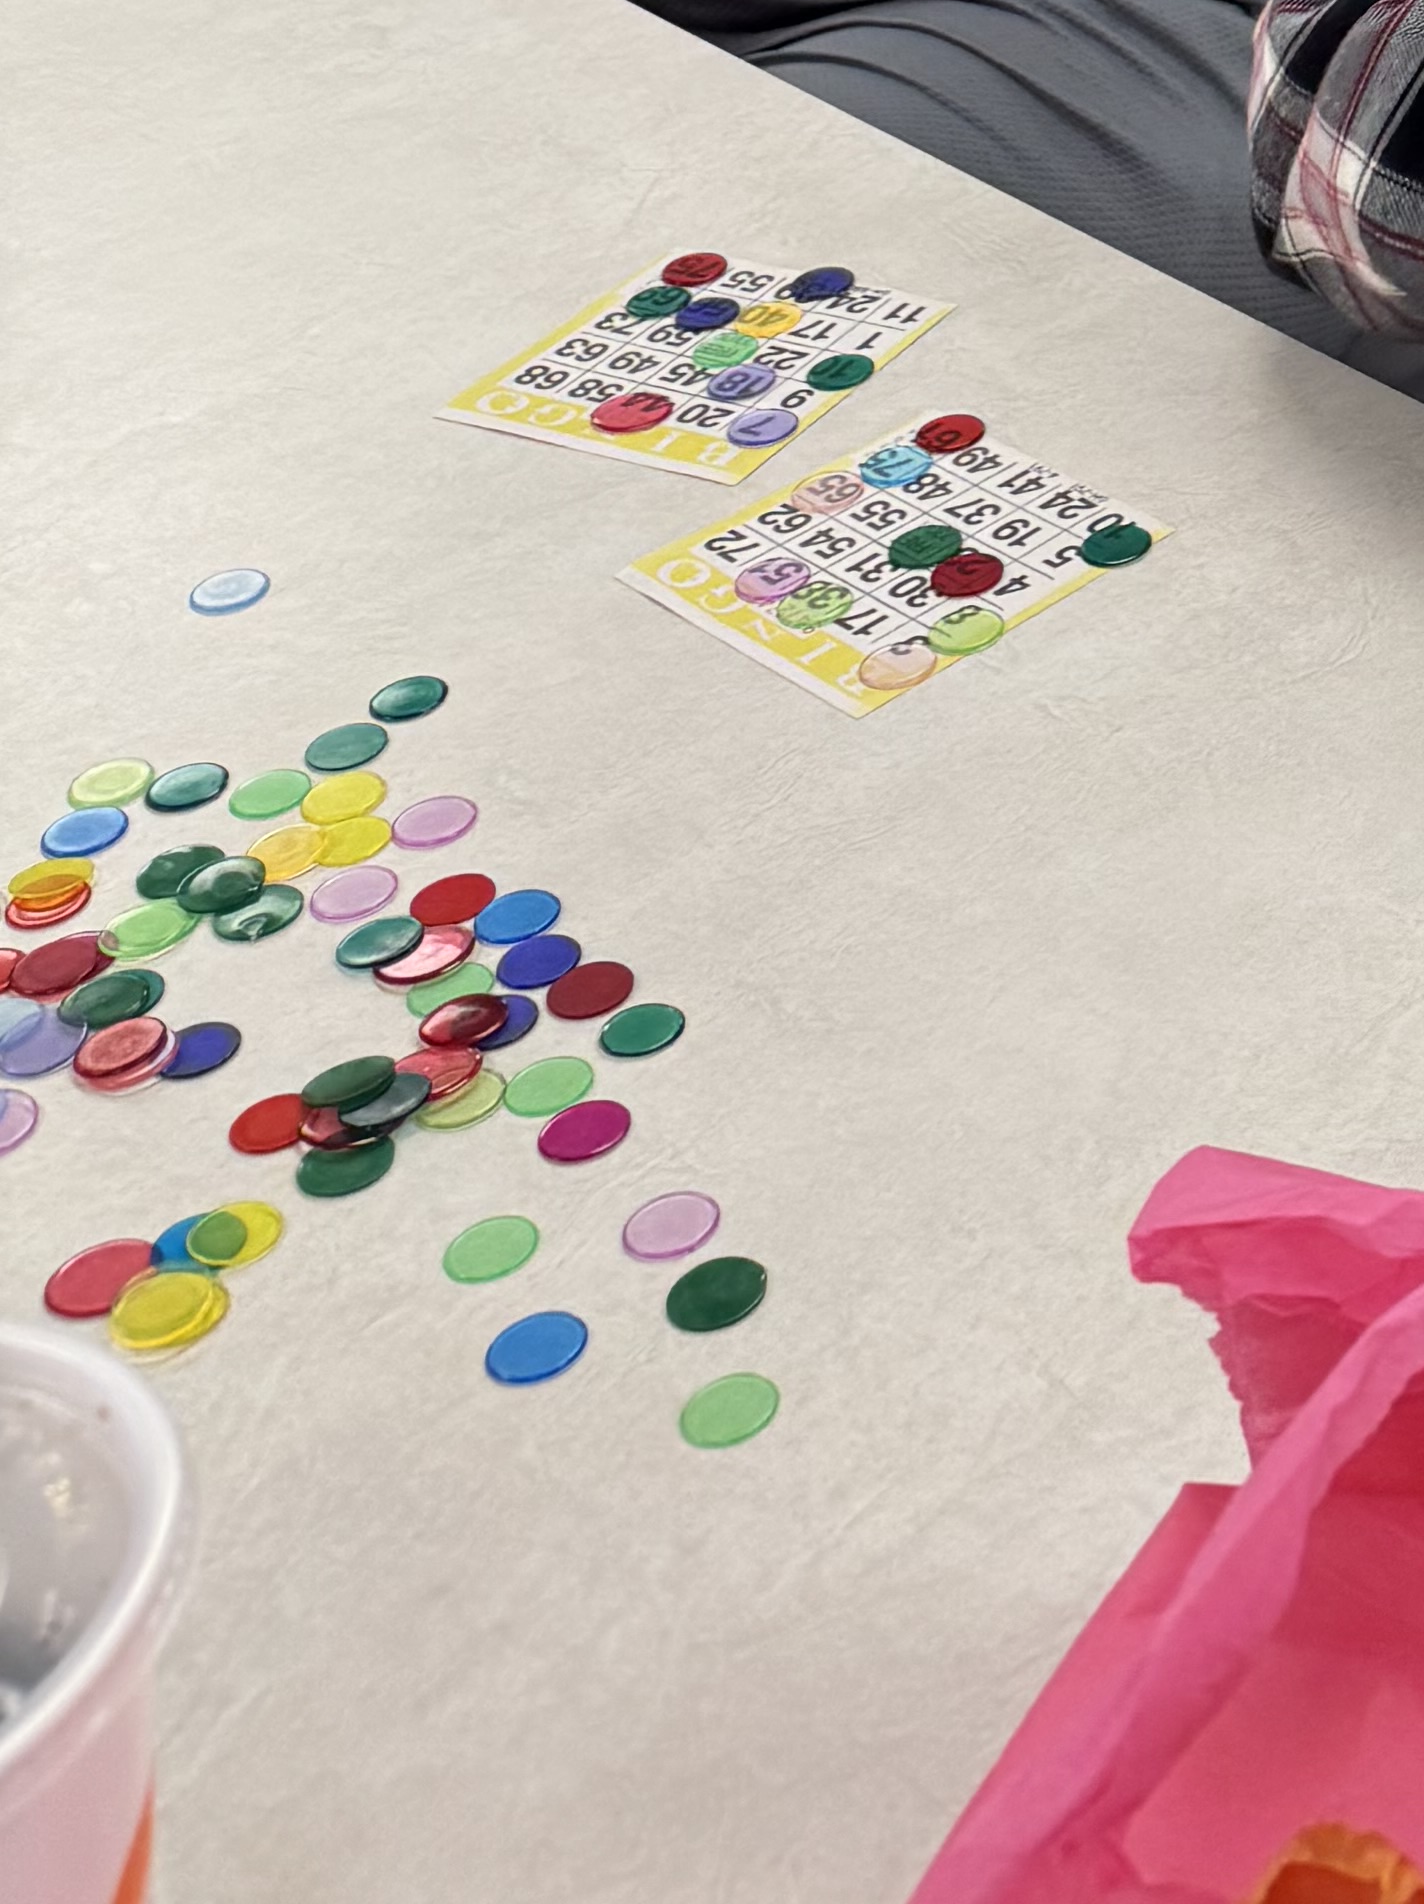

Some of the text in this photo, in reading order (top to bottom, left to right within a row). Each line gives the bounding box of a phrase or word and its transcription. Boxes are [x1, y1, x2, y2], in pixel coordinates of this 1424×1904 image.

[720, 270, 774, 292] 55
[742, 304, 789, 327] 40
[826, 292, 883, 314] 24
[882, 302, 927, 324] 11
[595, 311, 645, 335] 73
[646, 324, 693, 347] 59
[788, 319, 837, 341] 17
[855, 331, 883, 350] 1
[753, 345, 809, 370] 22
[514, 365, 570, 390] 68
[555, 338, 815, 409] 9 18 45 49 63
[567, 378, 624, 402] 58
[677, 403, 735, 428] 20
[738, 415, 775, 437] 7
[952, 446, 1004, 474] 49
[902, 473, 955, 501] 48
[997, 469, 1048, 495] 41
[758, 503, 812, 533] 62
[943, 498, 1002, 526] 37
[1038, 491, 1099, 520] 24
[799, 528, 856, 559] 54
[807, 474, 1032, 597] 4 55 65
[992, 518, 1043, 547] 19
[704, 529, 760, 563] 72
[1042, 544, 1083, 568] 5
[845, 552, 898, 583] 31
[888, 575, 936, 608] 30
[834, 608, 890, 635] 17
